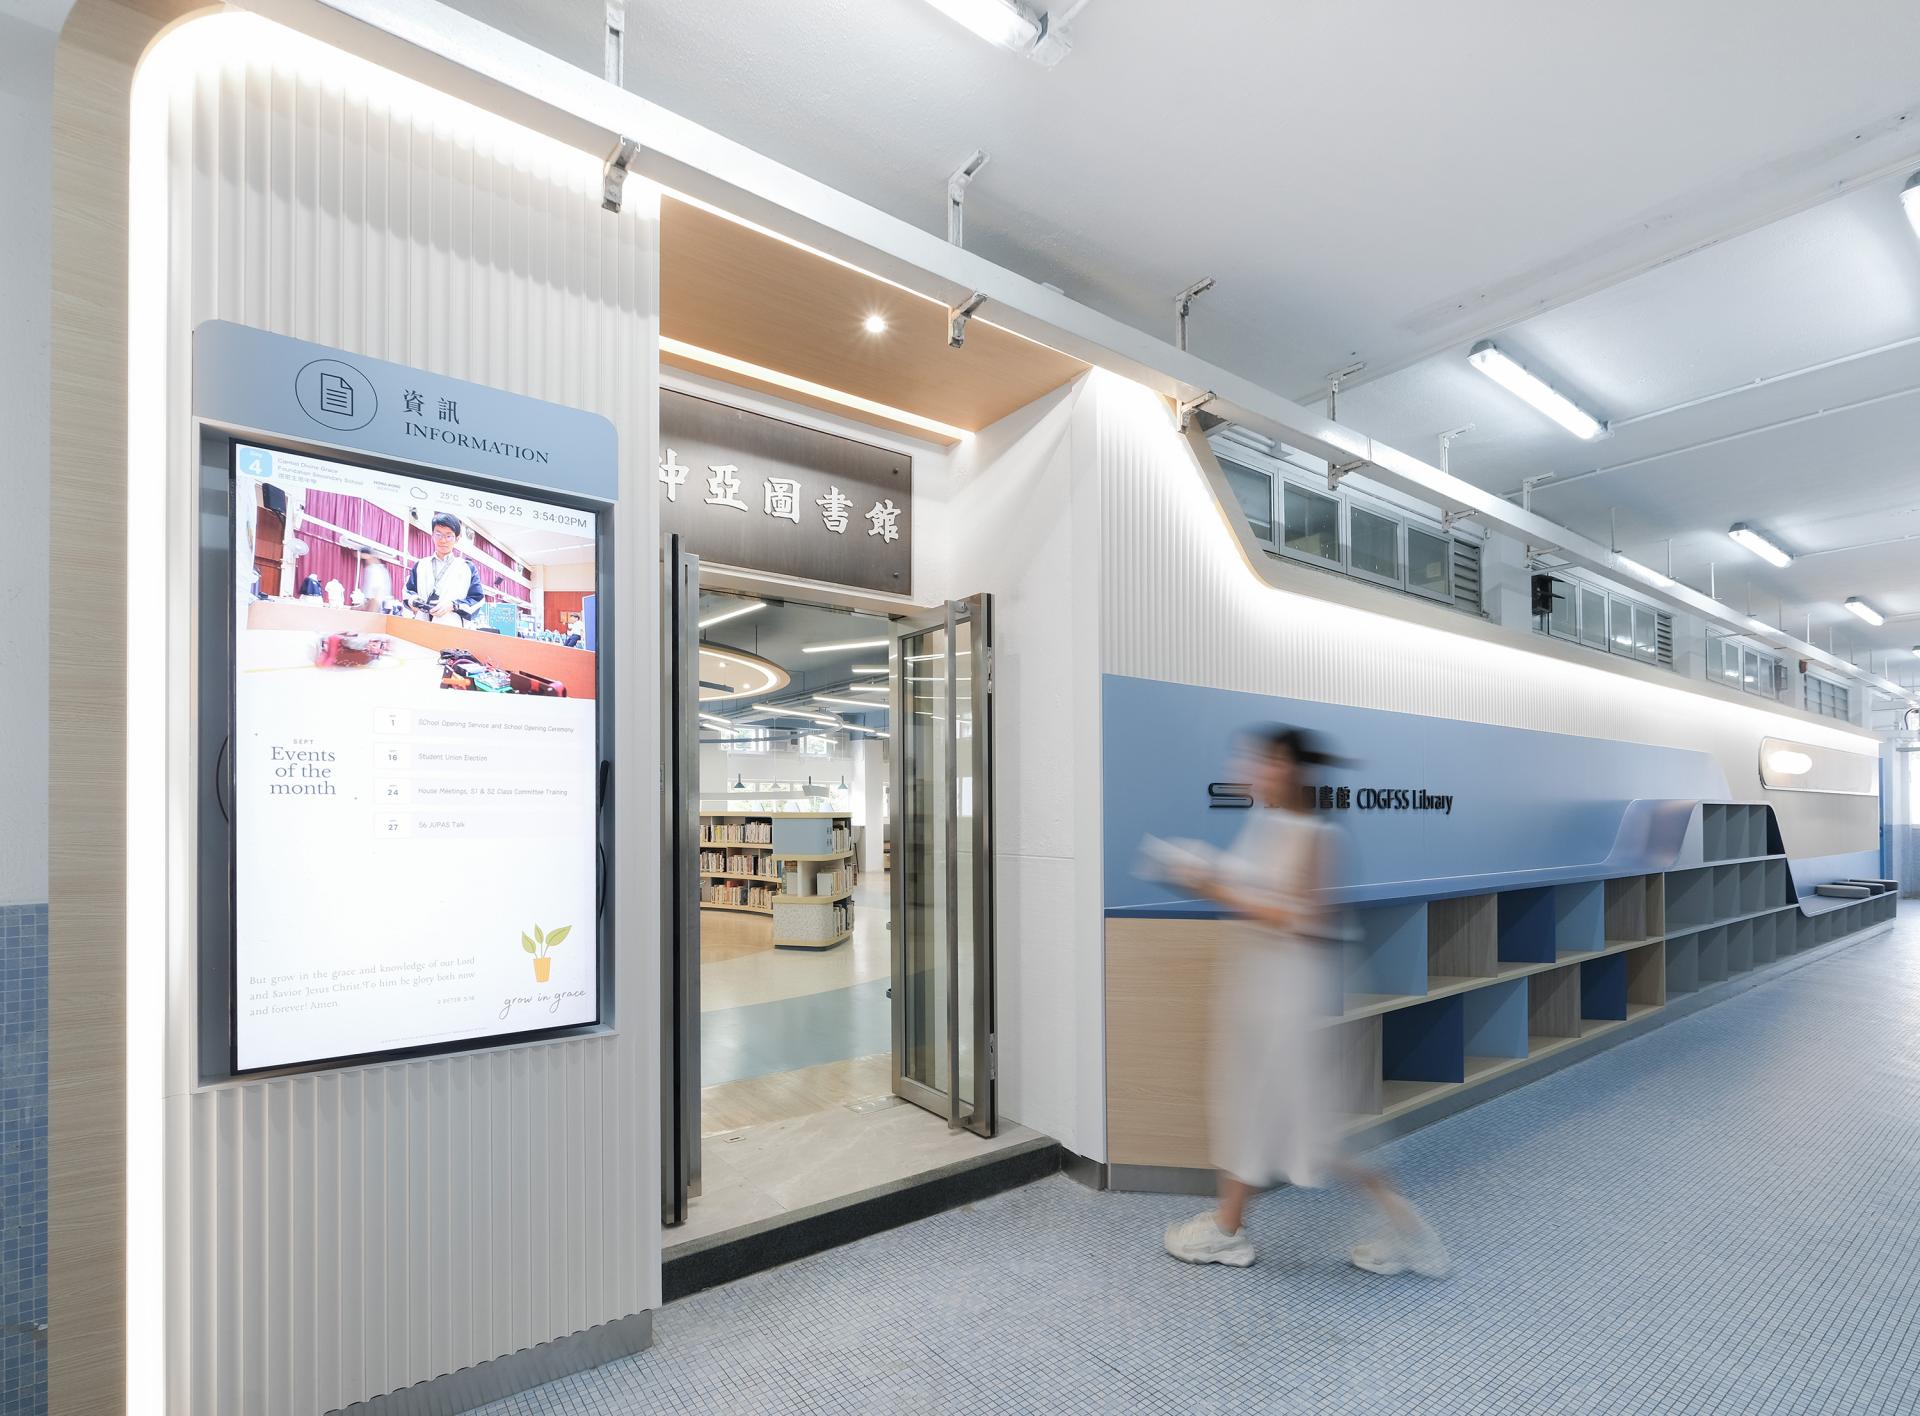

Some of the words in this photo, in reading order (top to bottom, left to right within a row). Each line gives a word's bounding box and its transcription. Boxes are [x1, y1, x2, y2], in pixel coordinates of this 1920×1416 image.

[402, 388, 461, 426] 資訊
[404, 421, 550, 465] INFORMATION
[248, 459, 263, 475] 4
[312, 472, 343, 483] Secondary
[468, 497, 483, 509] 30
[485, 502, 506, 515] Sep
[508, 505, 523, 517] 25
[532, 509, 587, 528] 3:54:02PM
[441, 719, 466, 729] Opening
[467, 721, 489, 729] Service
[490, 722, 502, 730] and
[503, 722, 523, 731] School
[523, 723, 547, 732] Opening
[547, 725, 575, 734] Ceremony
[270, 746, 337, 762] Events
[418, 752, 444, 761] Student
[464, 754, 488, 762] Election
[275, 762, 298, 778] of
[301, 763, 332, 778] the
[269, 780, 337, 796] month
[387, 788, 400, 797] 24
[418, 787, 437, 795] House
[514, 788, 545, 796] Committee
[546, 788, 568, 797] Training
[1356, 787, 1409, 810] CDGFSS
[1412, 788, 1454, 815] Library
[387, 822, 400, 832] 27
[249, 975, 266, 985] But
[270, 974, 296, 986] grow
[299, 972, 309, 981] in
[312, 969, 328, 980] the
[331, 969, 356, 981] grace
[359, 964, 376, 975] and
[379, 961, 426, 973] knowledge
[427, 959, 438, 969] of
[439, 960, 455, 968] our
[456, 955, 475, 967] Lord
[249, 989, 269, 1001] and
[272, 989, 302, 999] Savior
[305, 986, 330, 998] Jesus
[379, 978, 398, 988] him
[400, 975, 411, 985] be
[412, 974, 435, 988] glory
[436, 971, 455, 983] both
[457, 972, 476, 981] now
[249, 1005, 269, 1017] and
[498, 995, 533, 1020] grow
[537, 992, 551, 1002] in
[549, 989, 586, 1014] grace
